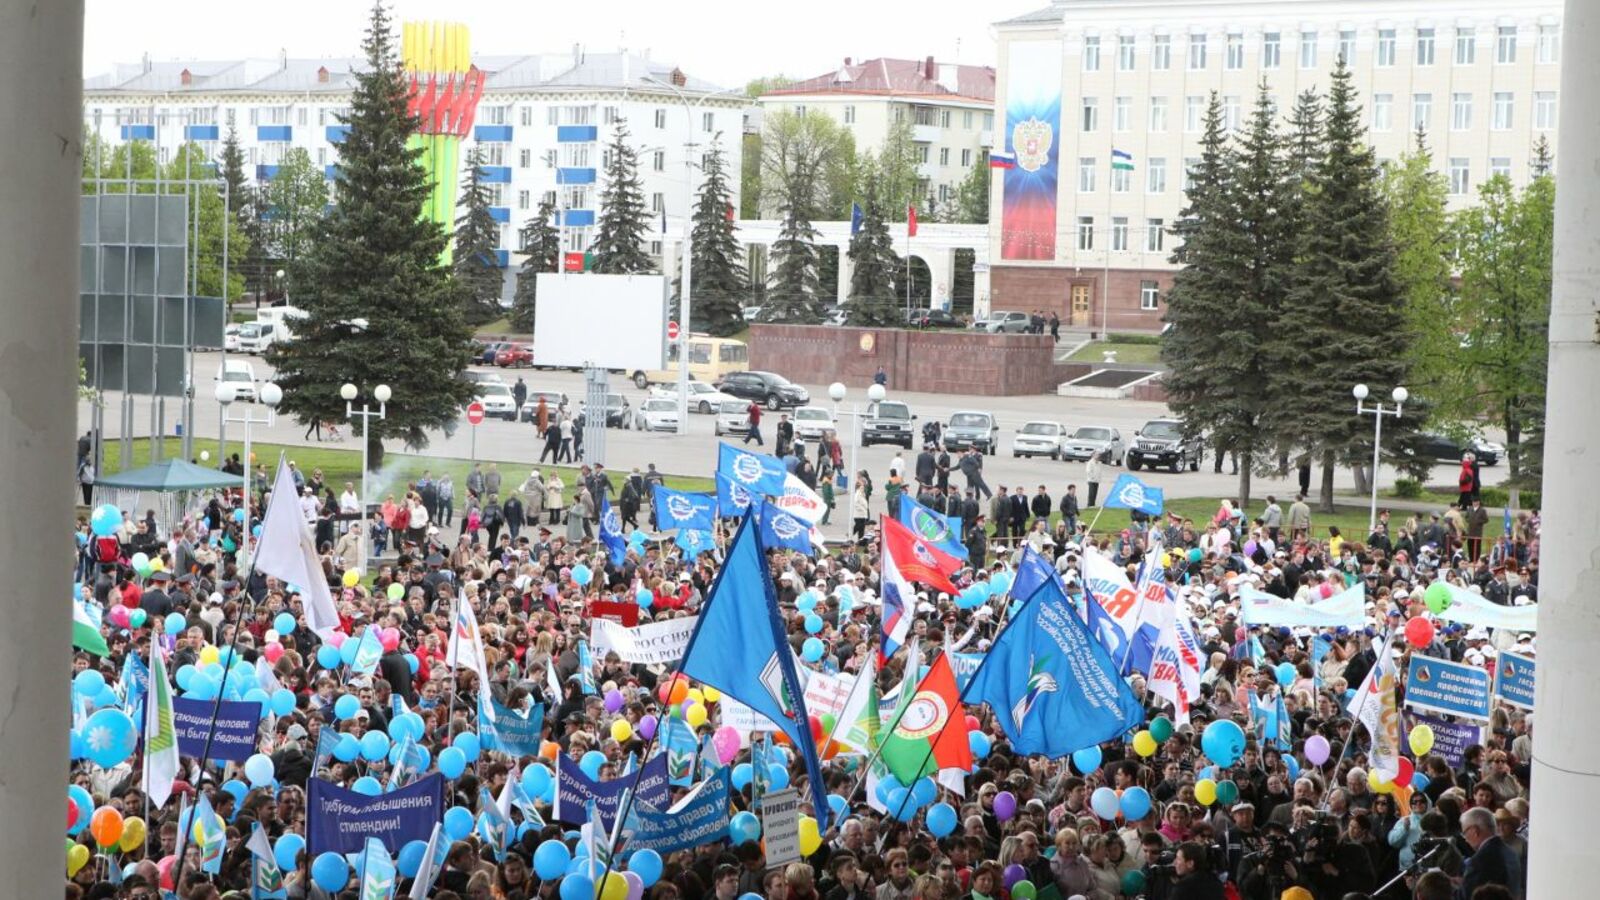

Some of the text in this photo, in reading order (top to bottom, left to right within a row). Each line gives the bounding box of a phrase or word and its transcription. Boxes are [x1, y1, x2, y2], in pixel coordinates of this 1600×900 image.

[215, 719, 250, 728] человек
[214, 731, 255, 744] бедным!
[679, 804, 715, 827] право
[340, 816, 401, 833] стипендии!
